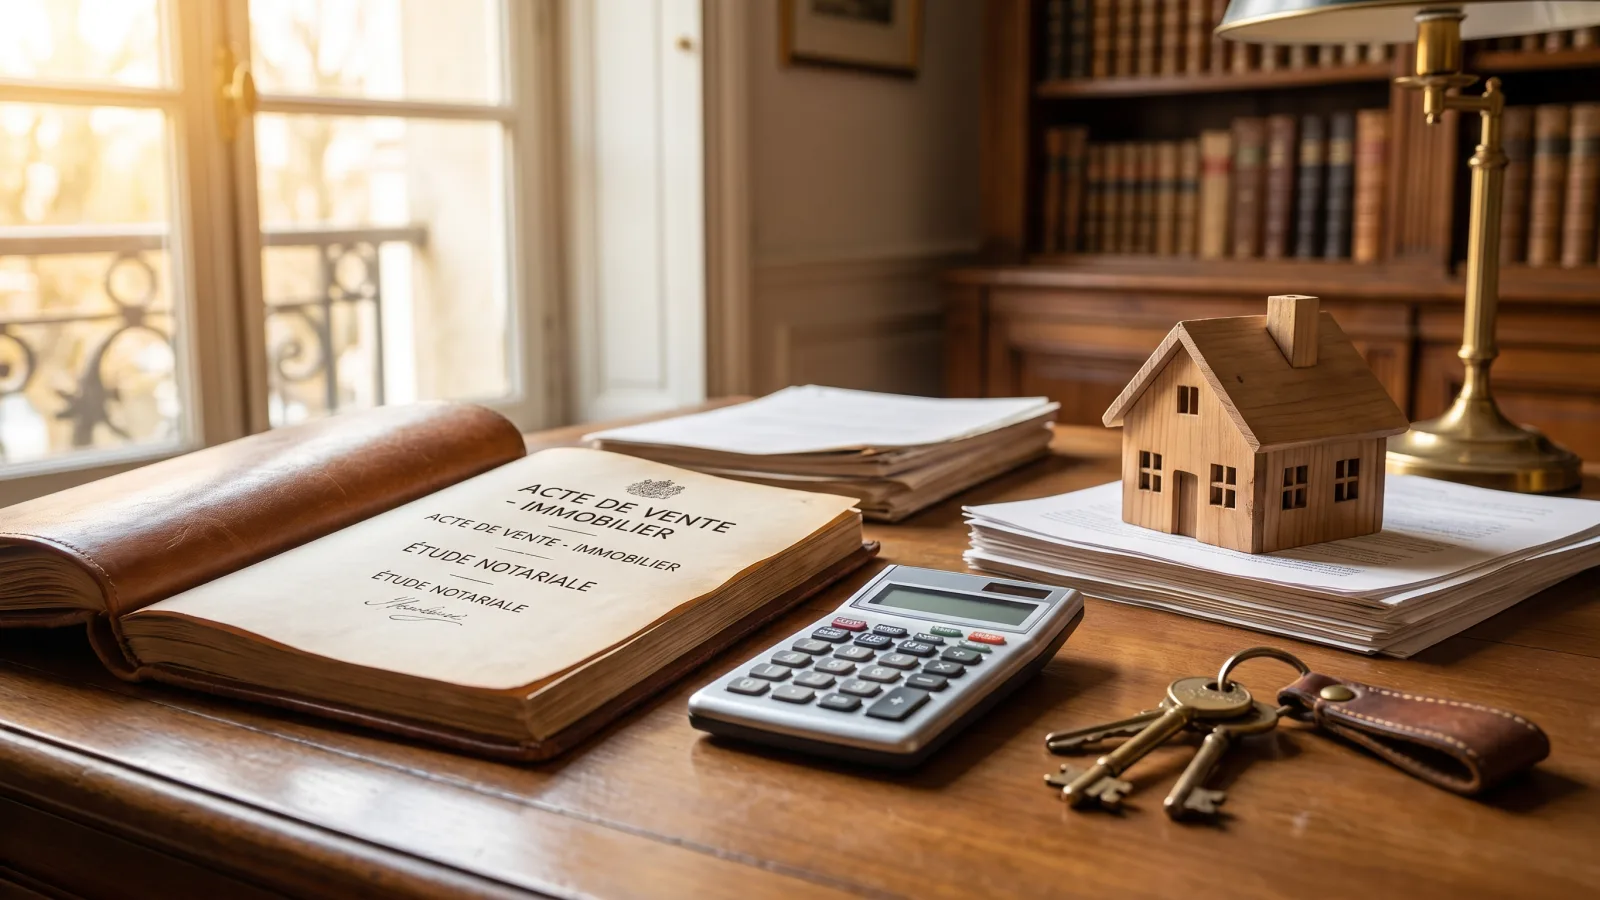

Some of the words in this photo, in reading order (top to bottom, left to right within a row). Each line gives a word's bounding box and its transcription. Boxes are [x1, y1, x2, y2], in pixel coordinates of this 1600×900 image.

[518, 484, 596, 505] ACTE
[593, 497, 639, 514] DE
[643, 506, 737, 534] VENTE
[519, 500, 675, 540] IMMOBILIER
[402, 541, 477, 565] ÉTUDE
[473, 558, 598, 593] NOTARIALE
[424, 513, 476, 529] ACTE
[473, 522, 502, 534] DE
[502, 527, 562, 548] VENTE
[571, 543, 682, 573] IMMOBILIER
[371, 570, 431, 590] ÉTUDE
[428, 584, 530, 614] NOTARIALE
